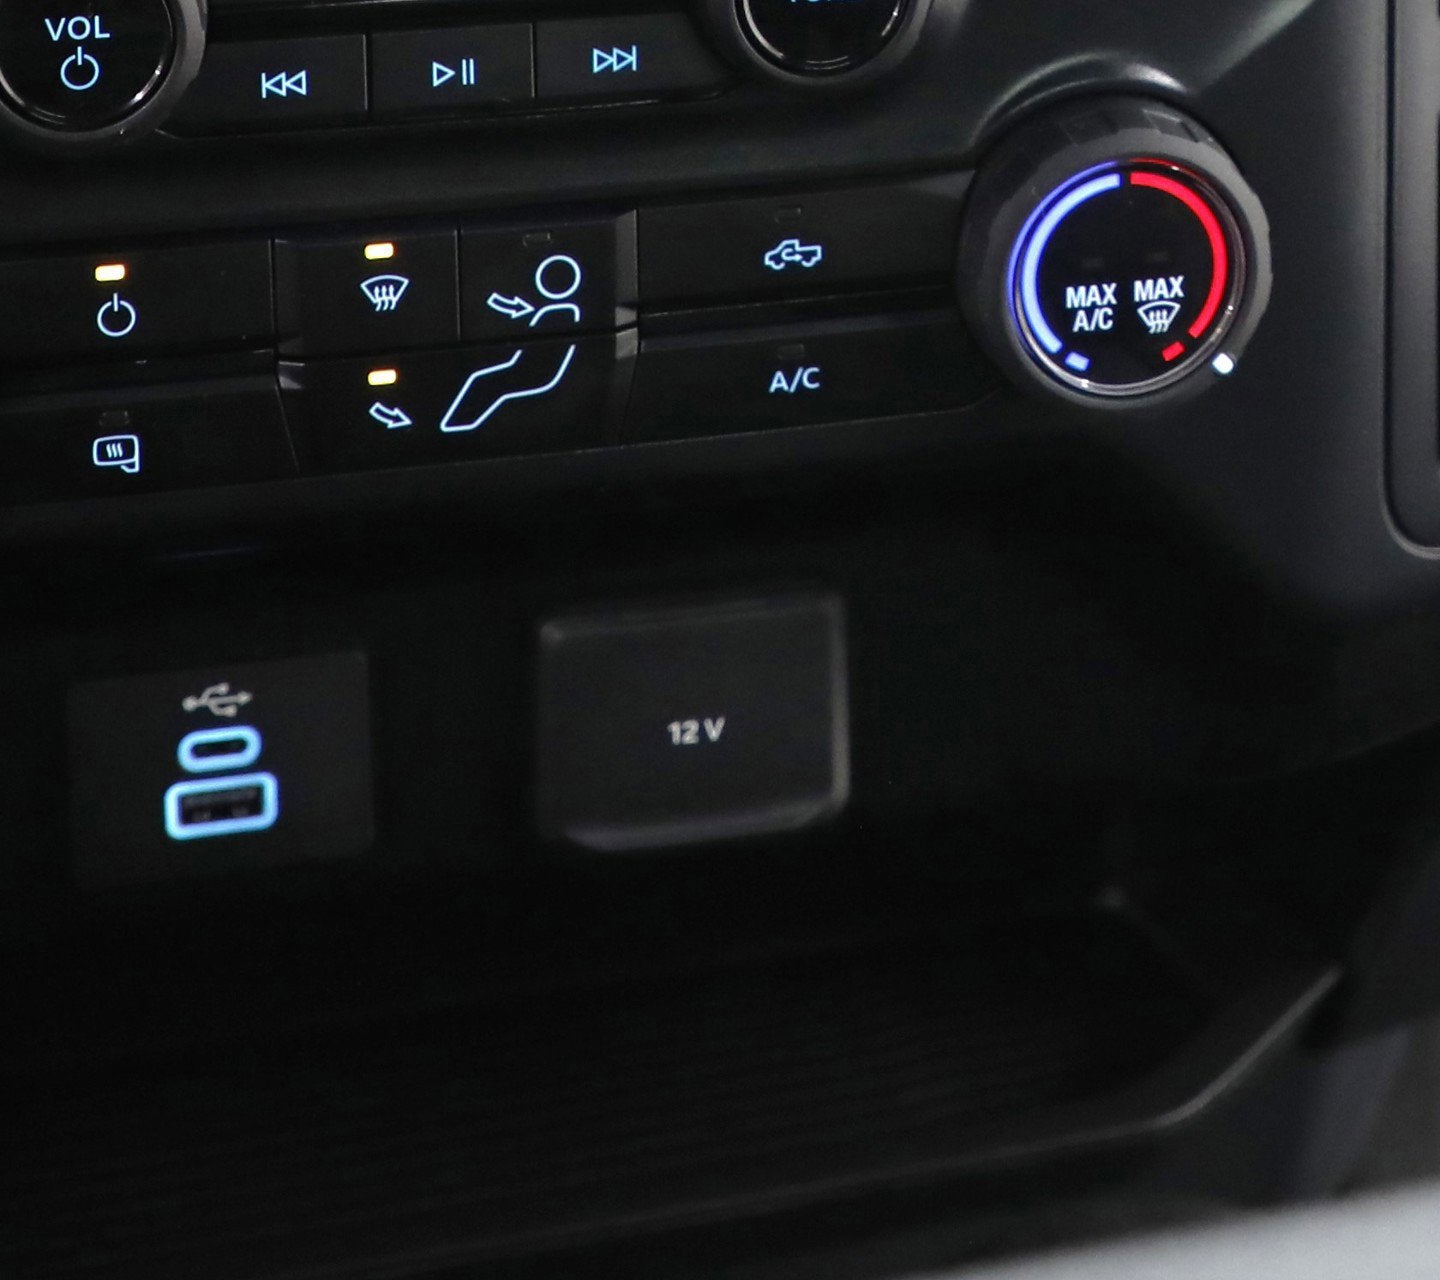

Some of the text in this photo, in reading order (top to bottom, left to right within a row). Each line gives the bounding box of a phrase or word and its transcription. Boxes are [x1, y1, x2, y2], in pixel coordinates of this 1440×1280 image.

[44, 15, 111, 42] VOL
[1066, 282, 1118, 308] MAX
[1134, 275, 1185, 302] MAX
[1072, 307, 1114, 334] A/C
[769, 367, 820, 393] A/C
[668, 717, 725, 745] 12 V
